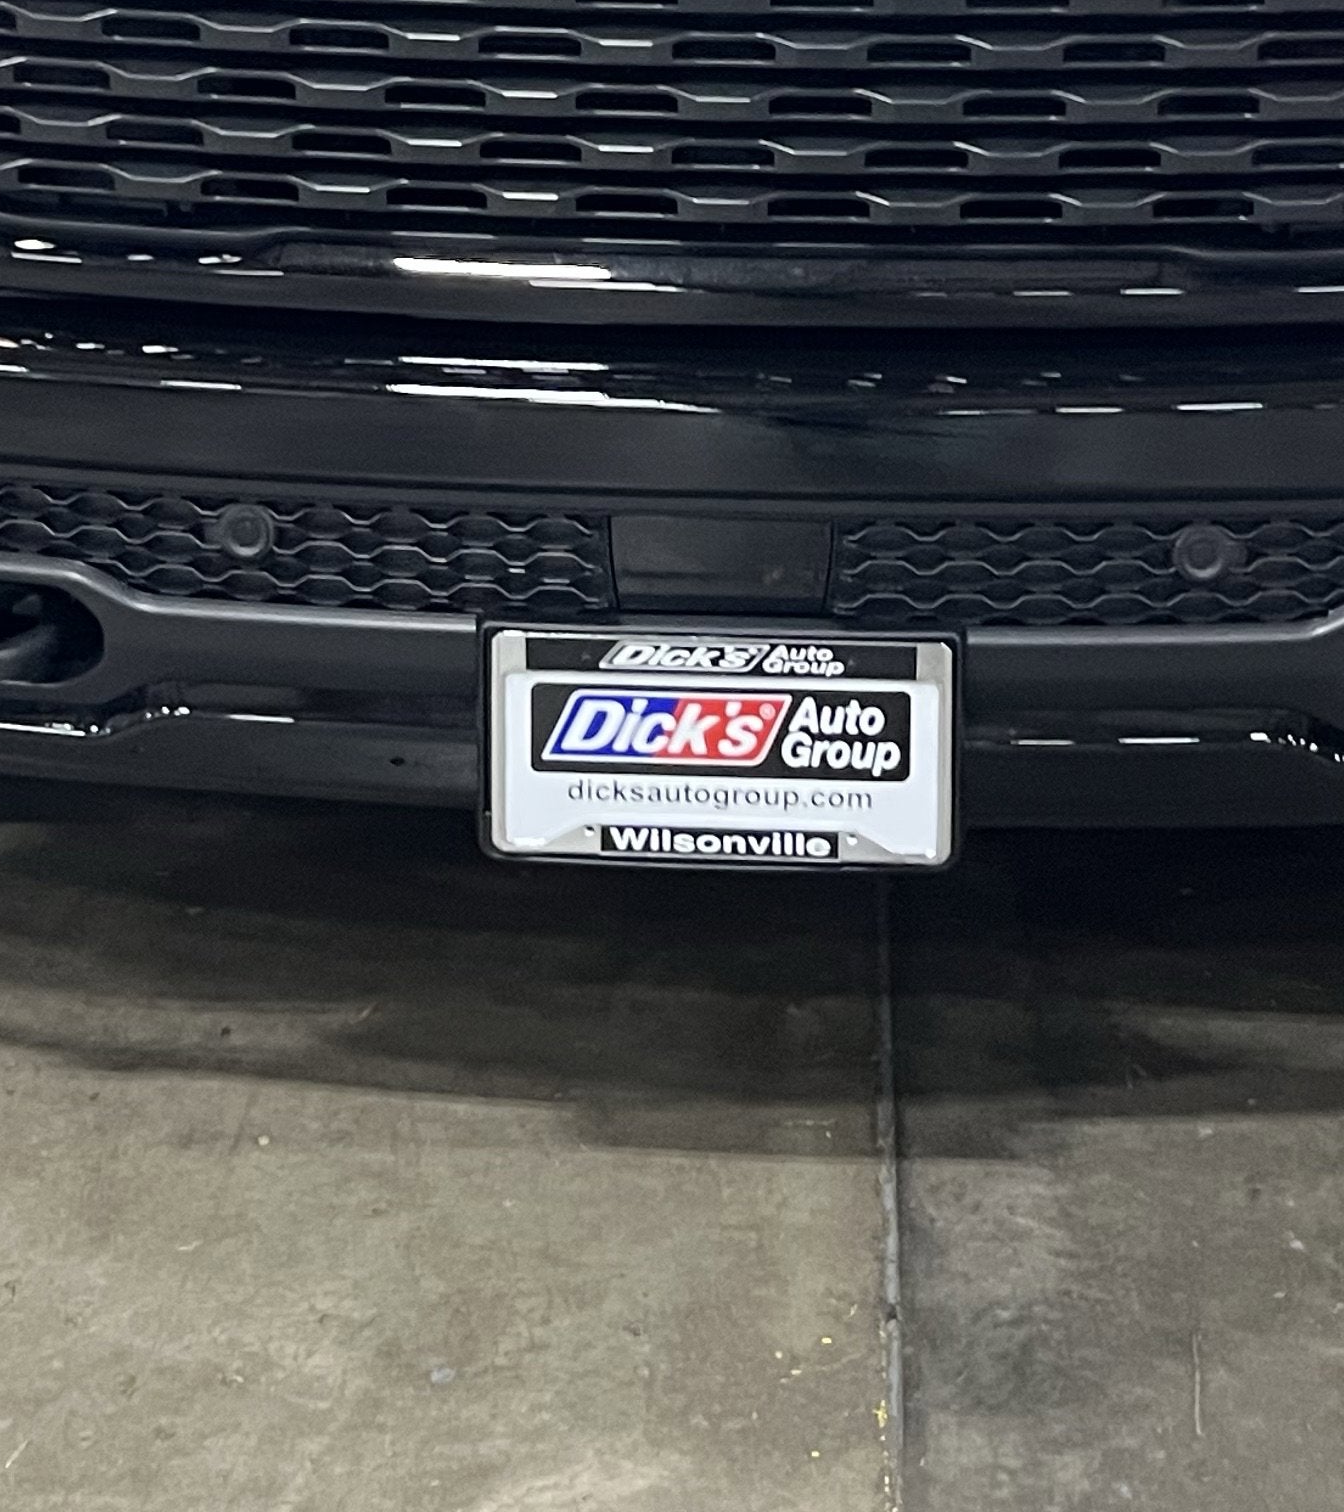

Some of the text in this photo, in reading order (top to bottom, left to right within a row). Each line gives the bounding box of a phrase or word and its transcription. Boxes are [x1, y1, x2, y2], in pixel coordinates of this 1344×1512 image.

[762, 659, 845, 677] Group
[770, 644, 834, 662] Auto
[559, 696, 886, 755] Dick's Auto
[780, 730, 901, 777] Group
[567, 778, 873, 811] dicksautogroup.com
[609, 825, 832, 857] Wilsonville
